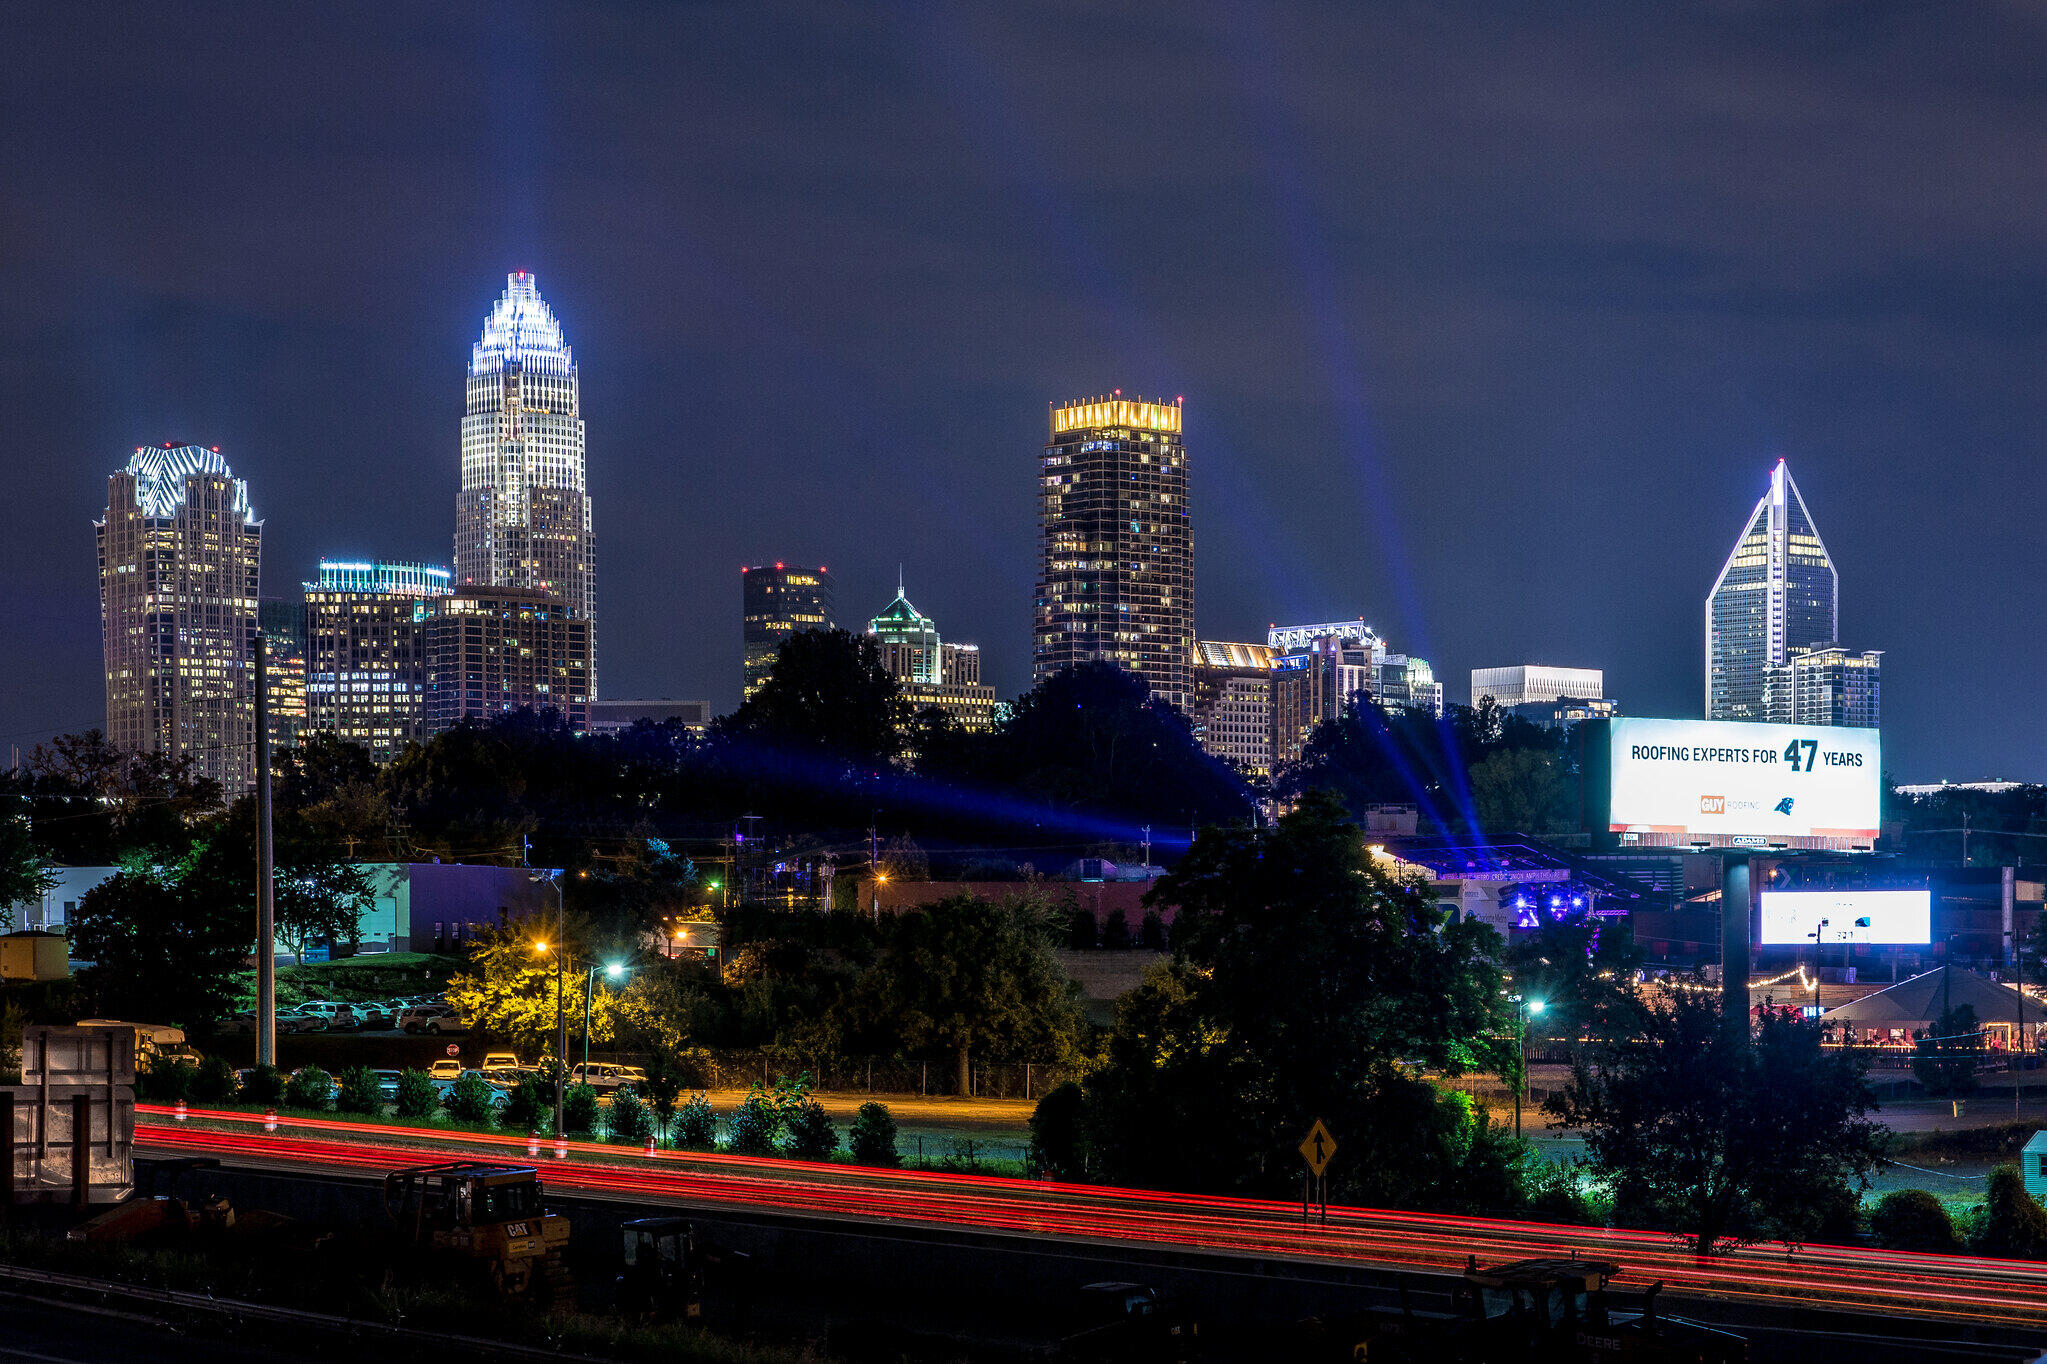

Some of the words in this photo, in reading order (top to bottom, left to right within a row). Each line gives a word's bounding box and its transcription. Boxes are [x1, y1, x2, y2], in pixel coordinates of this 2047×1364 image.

[1632, 745, 1689, 762] ROOFING
[1693, 747, 1749, 763] EXPERTS
[1753, 749, 1777, 764] FOR
[1783, 739, 1819, 773] 47
[1823, 752, 1863, 767] YEARS
[1701, 797, 1724, 812] GUY
[1727, 801, 1760, 810] ROOFING
[1735, 837, 1765, 845] ADAMS
[507, 1222, 529, 1237] CAT
[1576, 1332, 1622, 1350] DEERE
